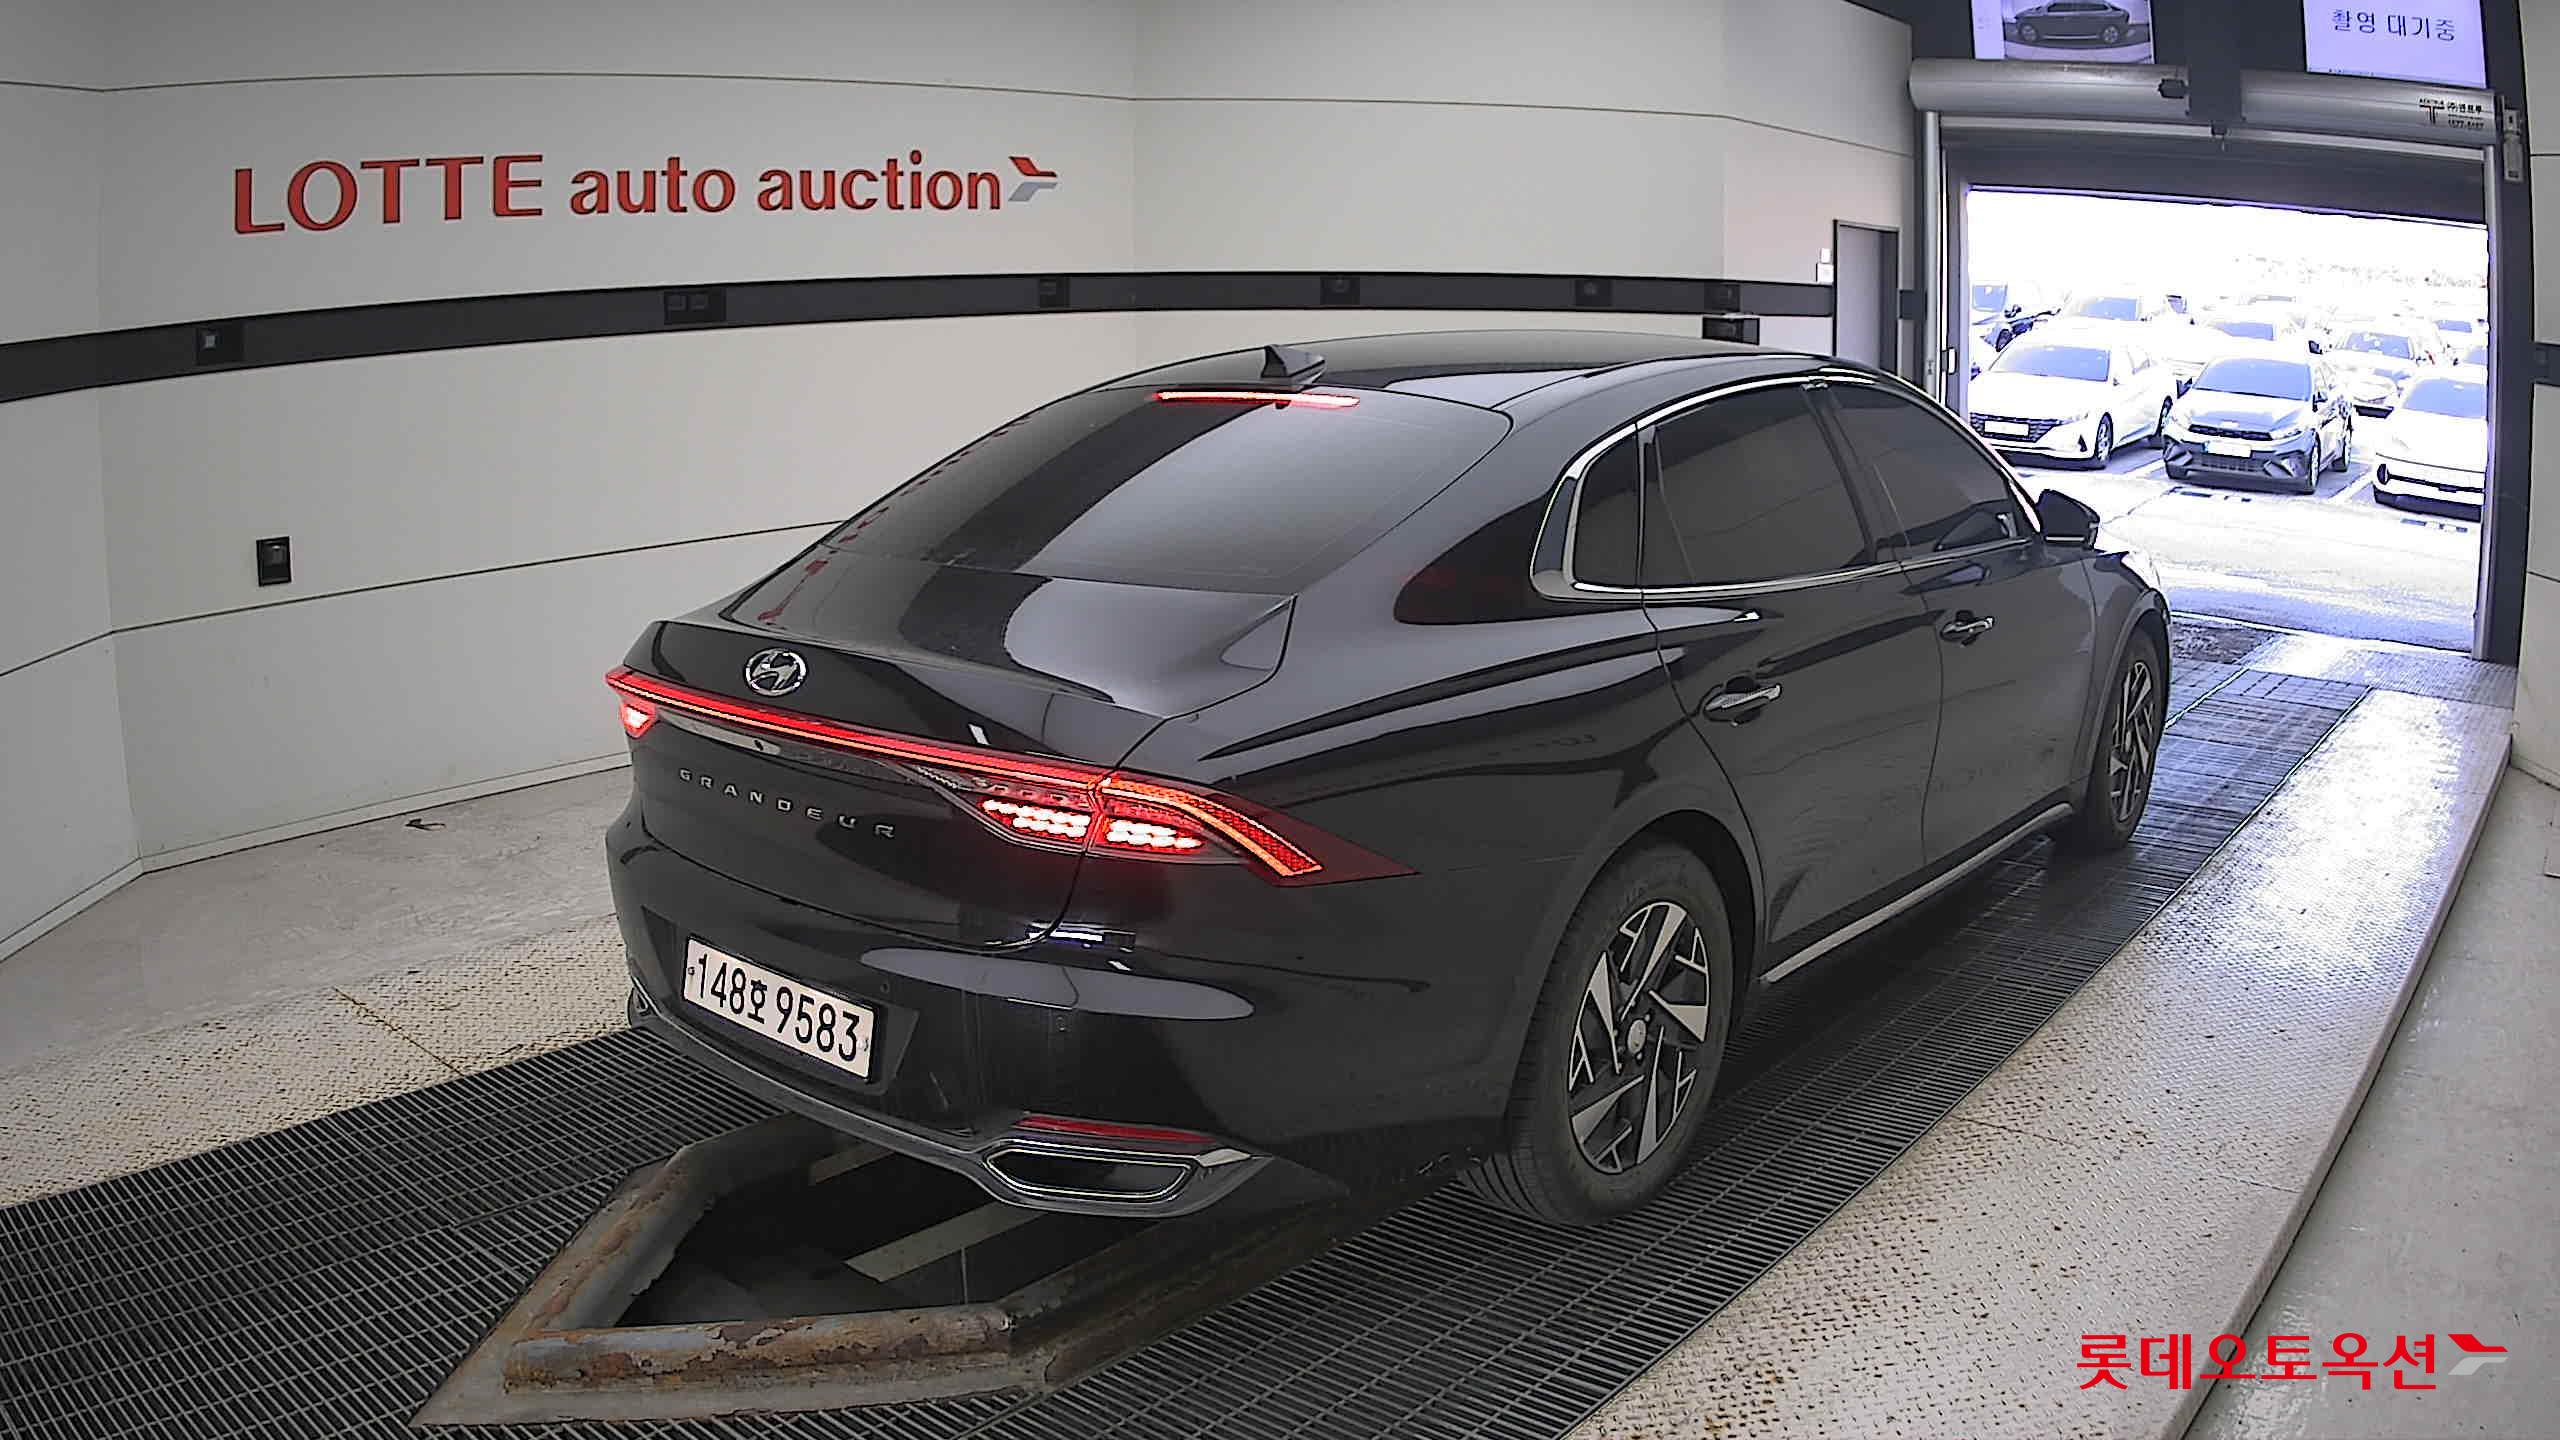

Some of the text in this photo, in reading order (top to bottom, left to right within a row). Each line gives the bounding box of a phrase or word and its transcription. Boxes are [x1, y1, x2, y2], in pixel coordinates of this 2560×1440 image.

[234, 149, 1002, 235] LOTTE auto auction
[679, 767, 896, 839] GRANDEUR
[776, 986, 861, 1062] 9583
